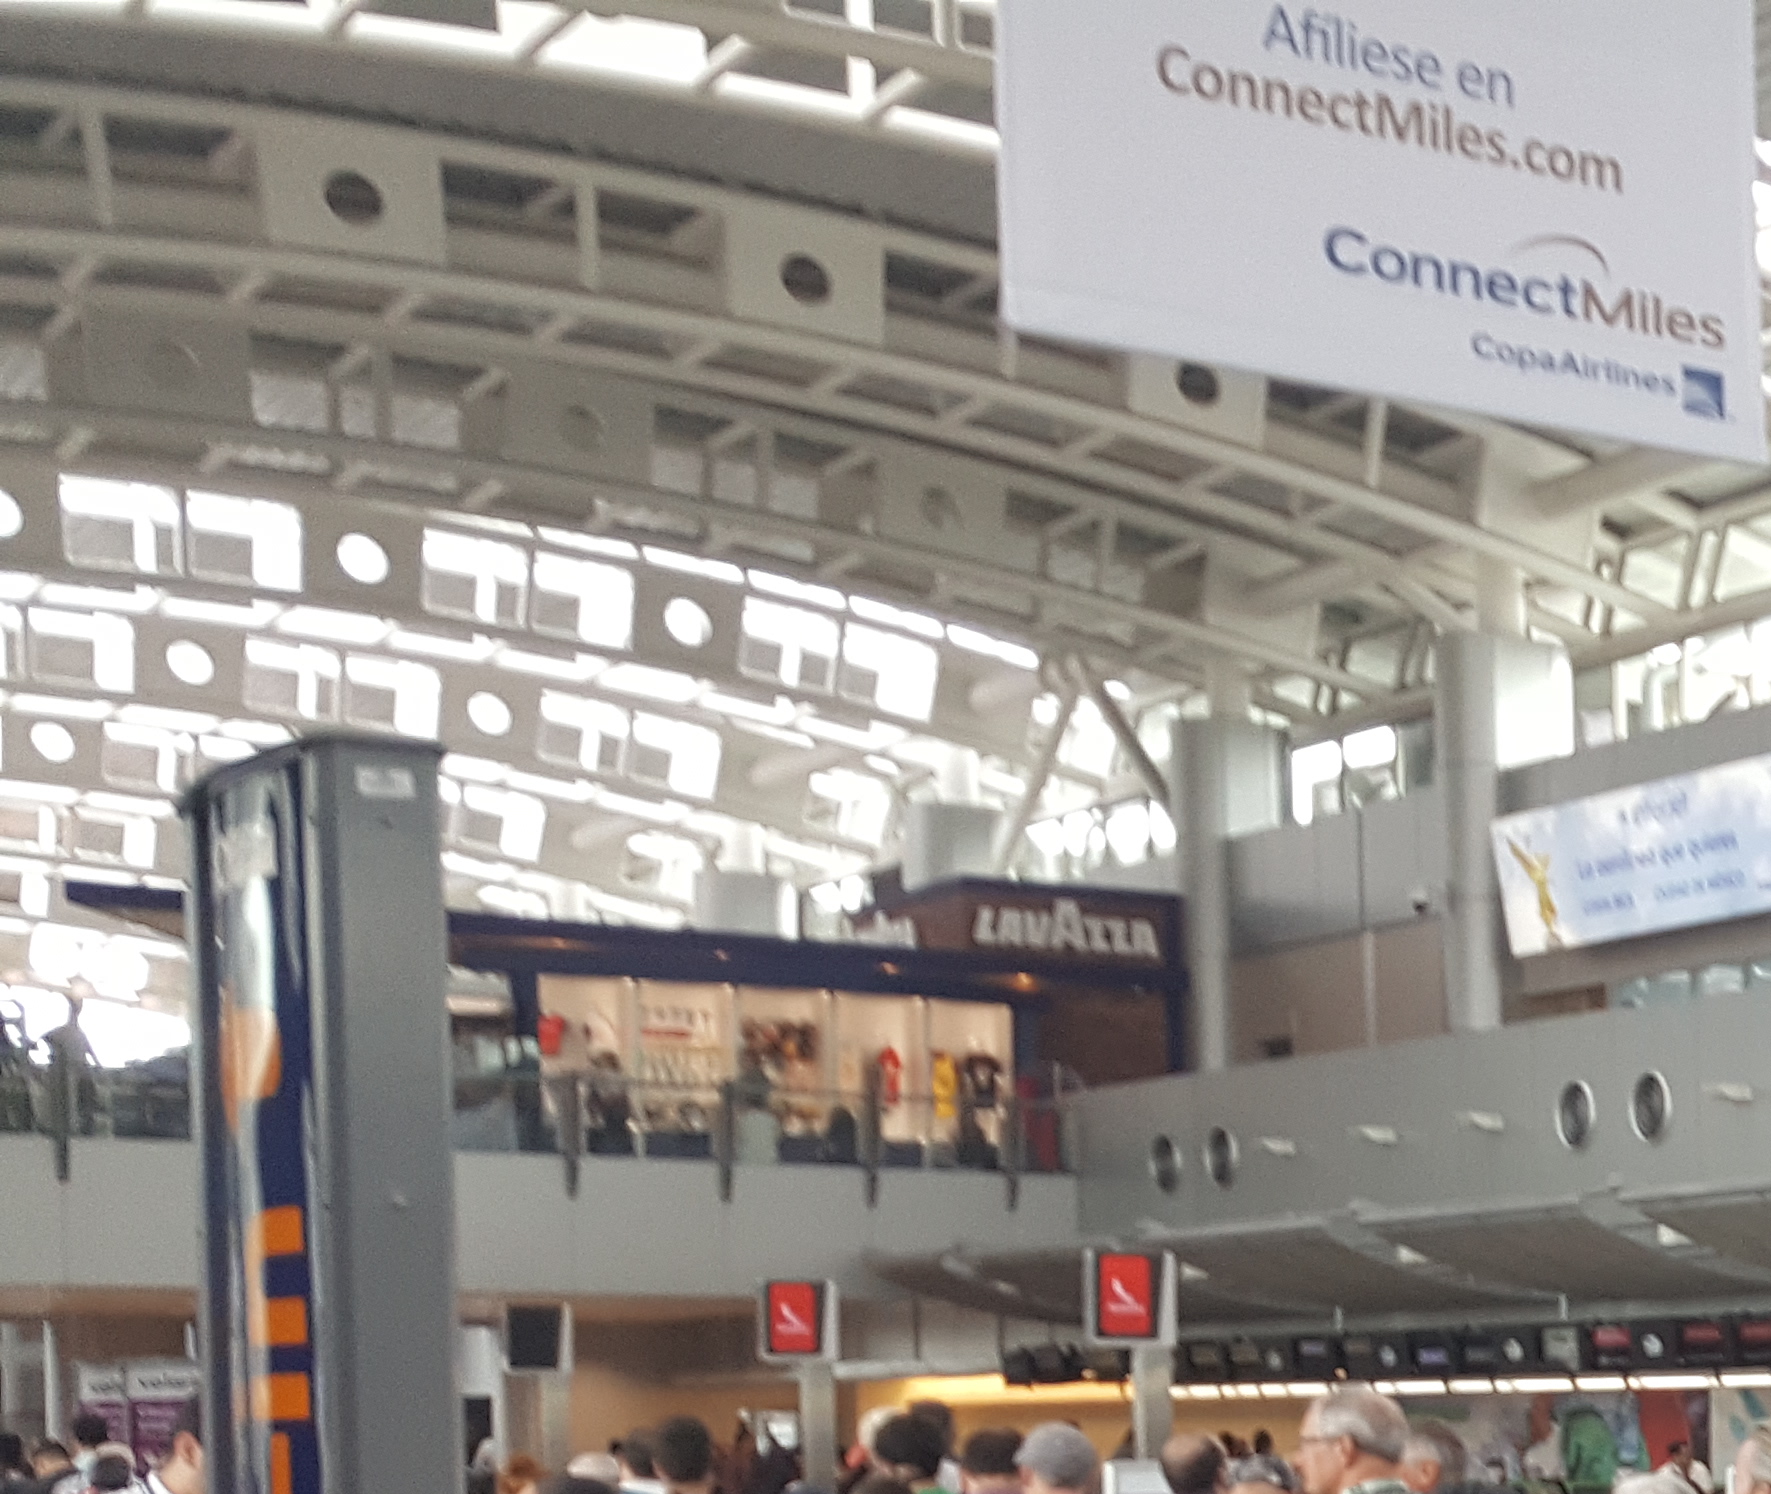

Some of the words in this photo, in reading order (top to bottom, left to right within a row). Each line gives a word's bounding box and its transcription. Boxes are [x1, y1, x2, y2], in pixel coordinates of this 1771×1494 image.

[1156, 42, 1625, 194] ConnectMiles.com
[1459, 63, 1517, 106] en
[1323, 225, 1726, 350] ConnectMiles
